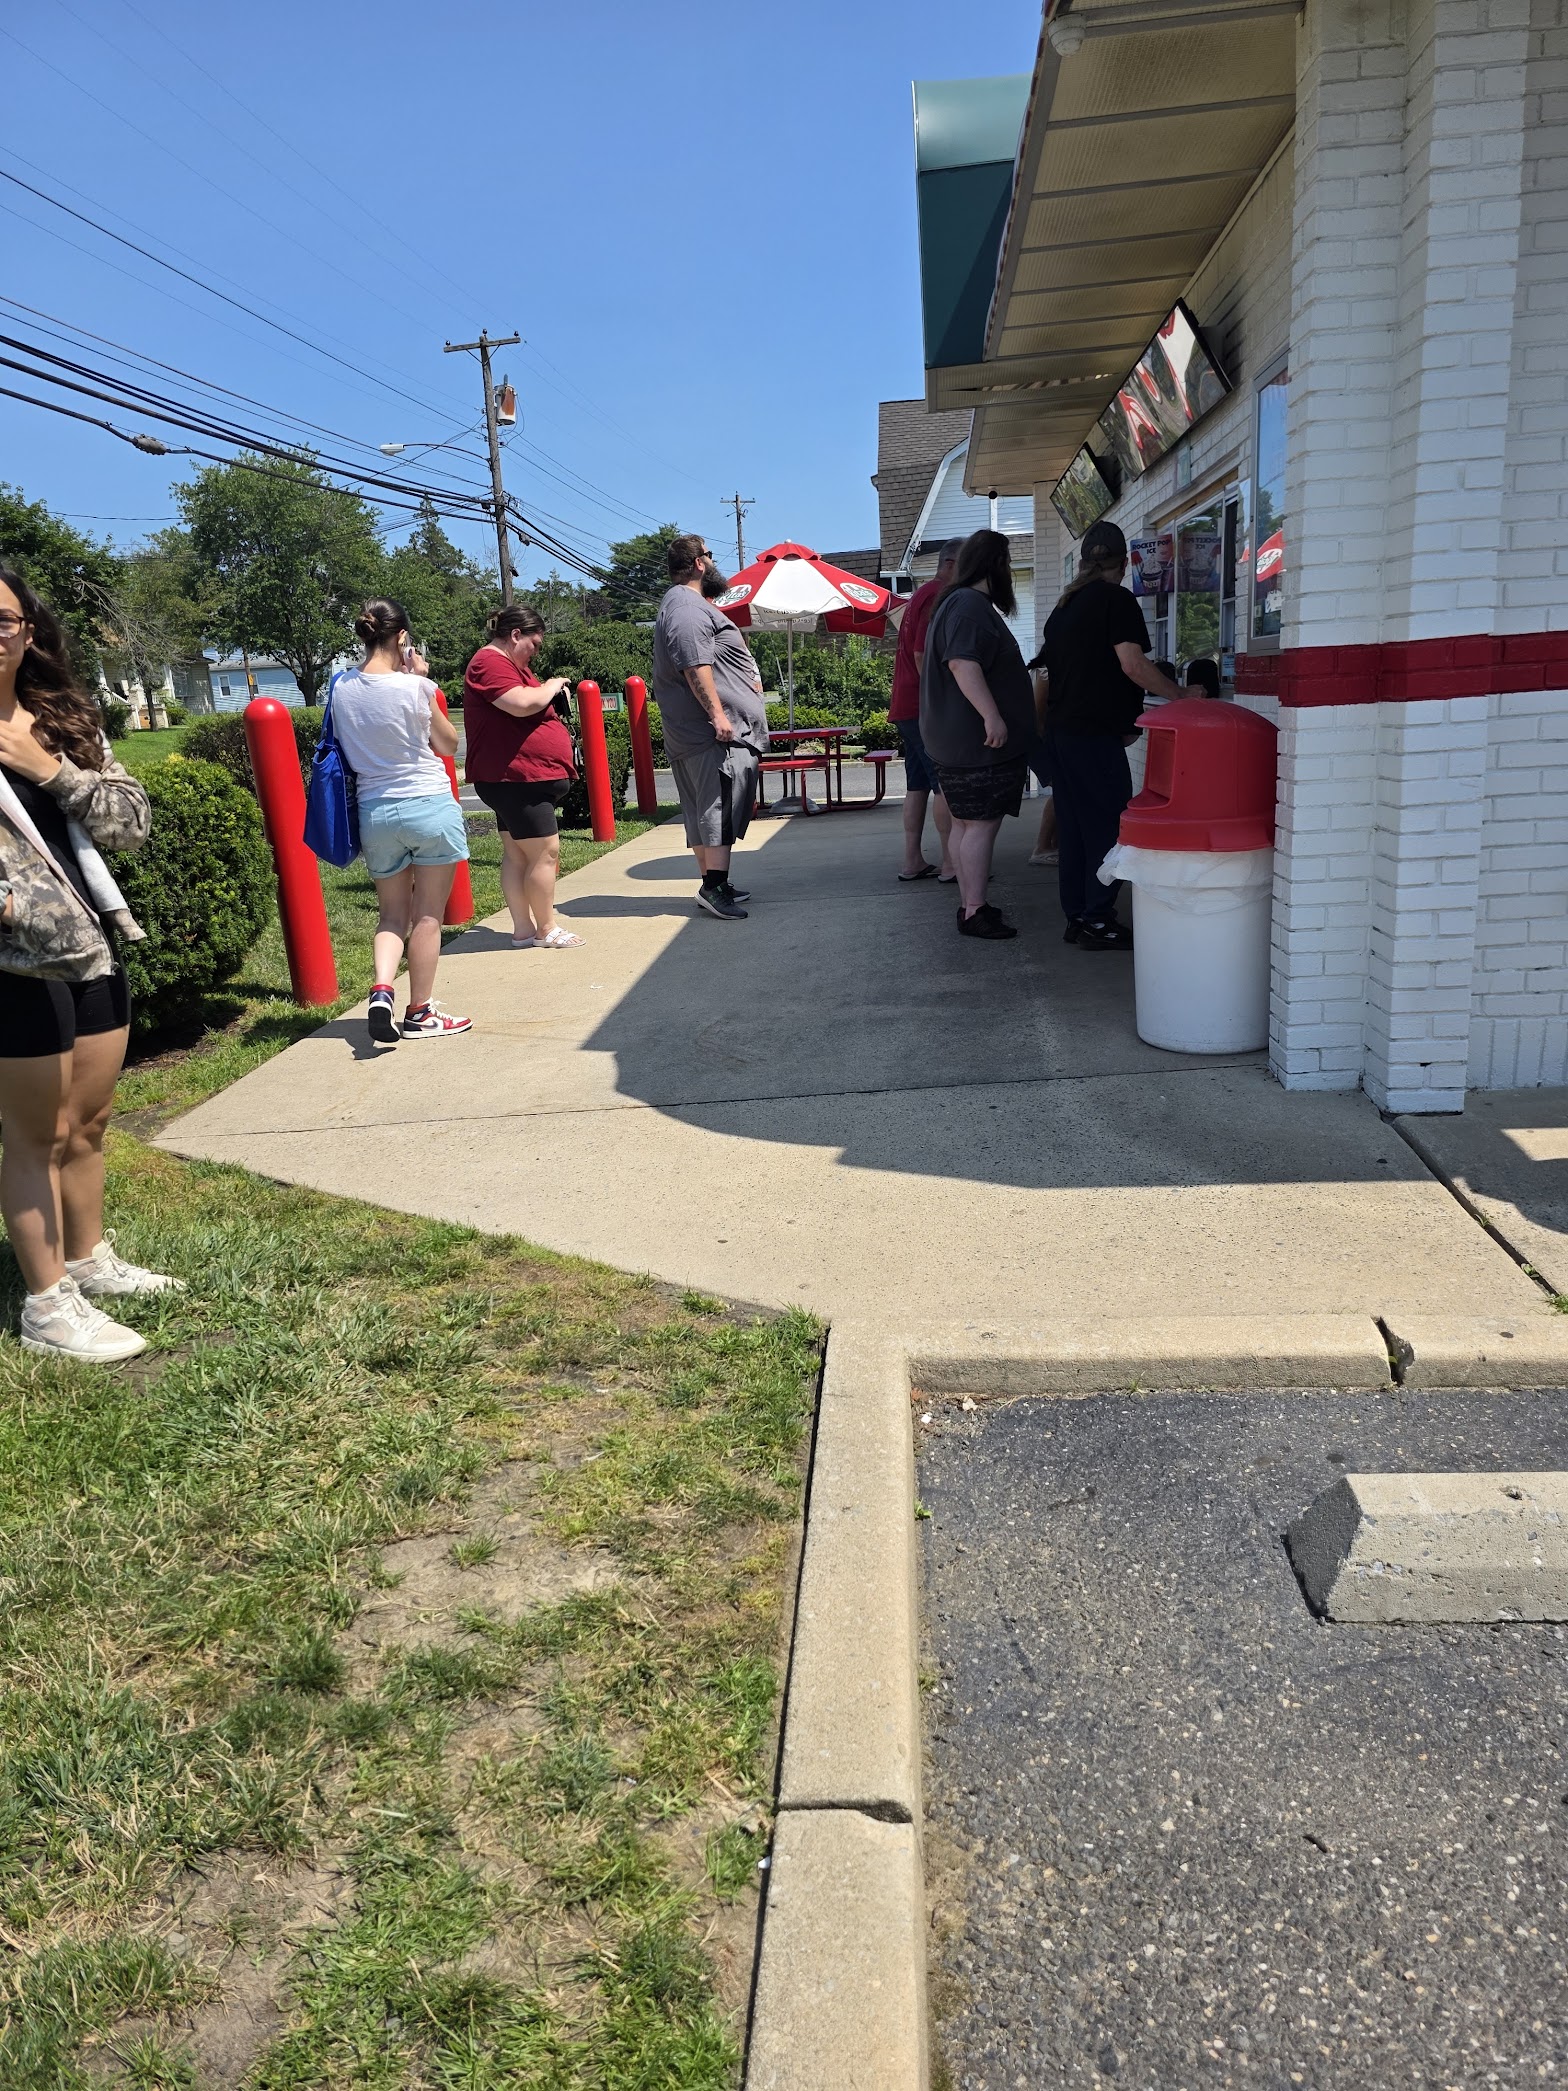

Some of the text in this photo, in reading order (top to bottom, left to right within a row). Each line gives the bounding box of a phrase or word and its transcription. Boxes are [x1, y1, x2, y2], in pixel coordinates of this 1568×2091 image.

[1132, 539, 1171, 551] ROCKET POP
[606, 697, 617, 709] YOU
